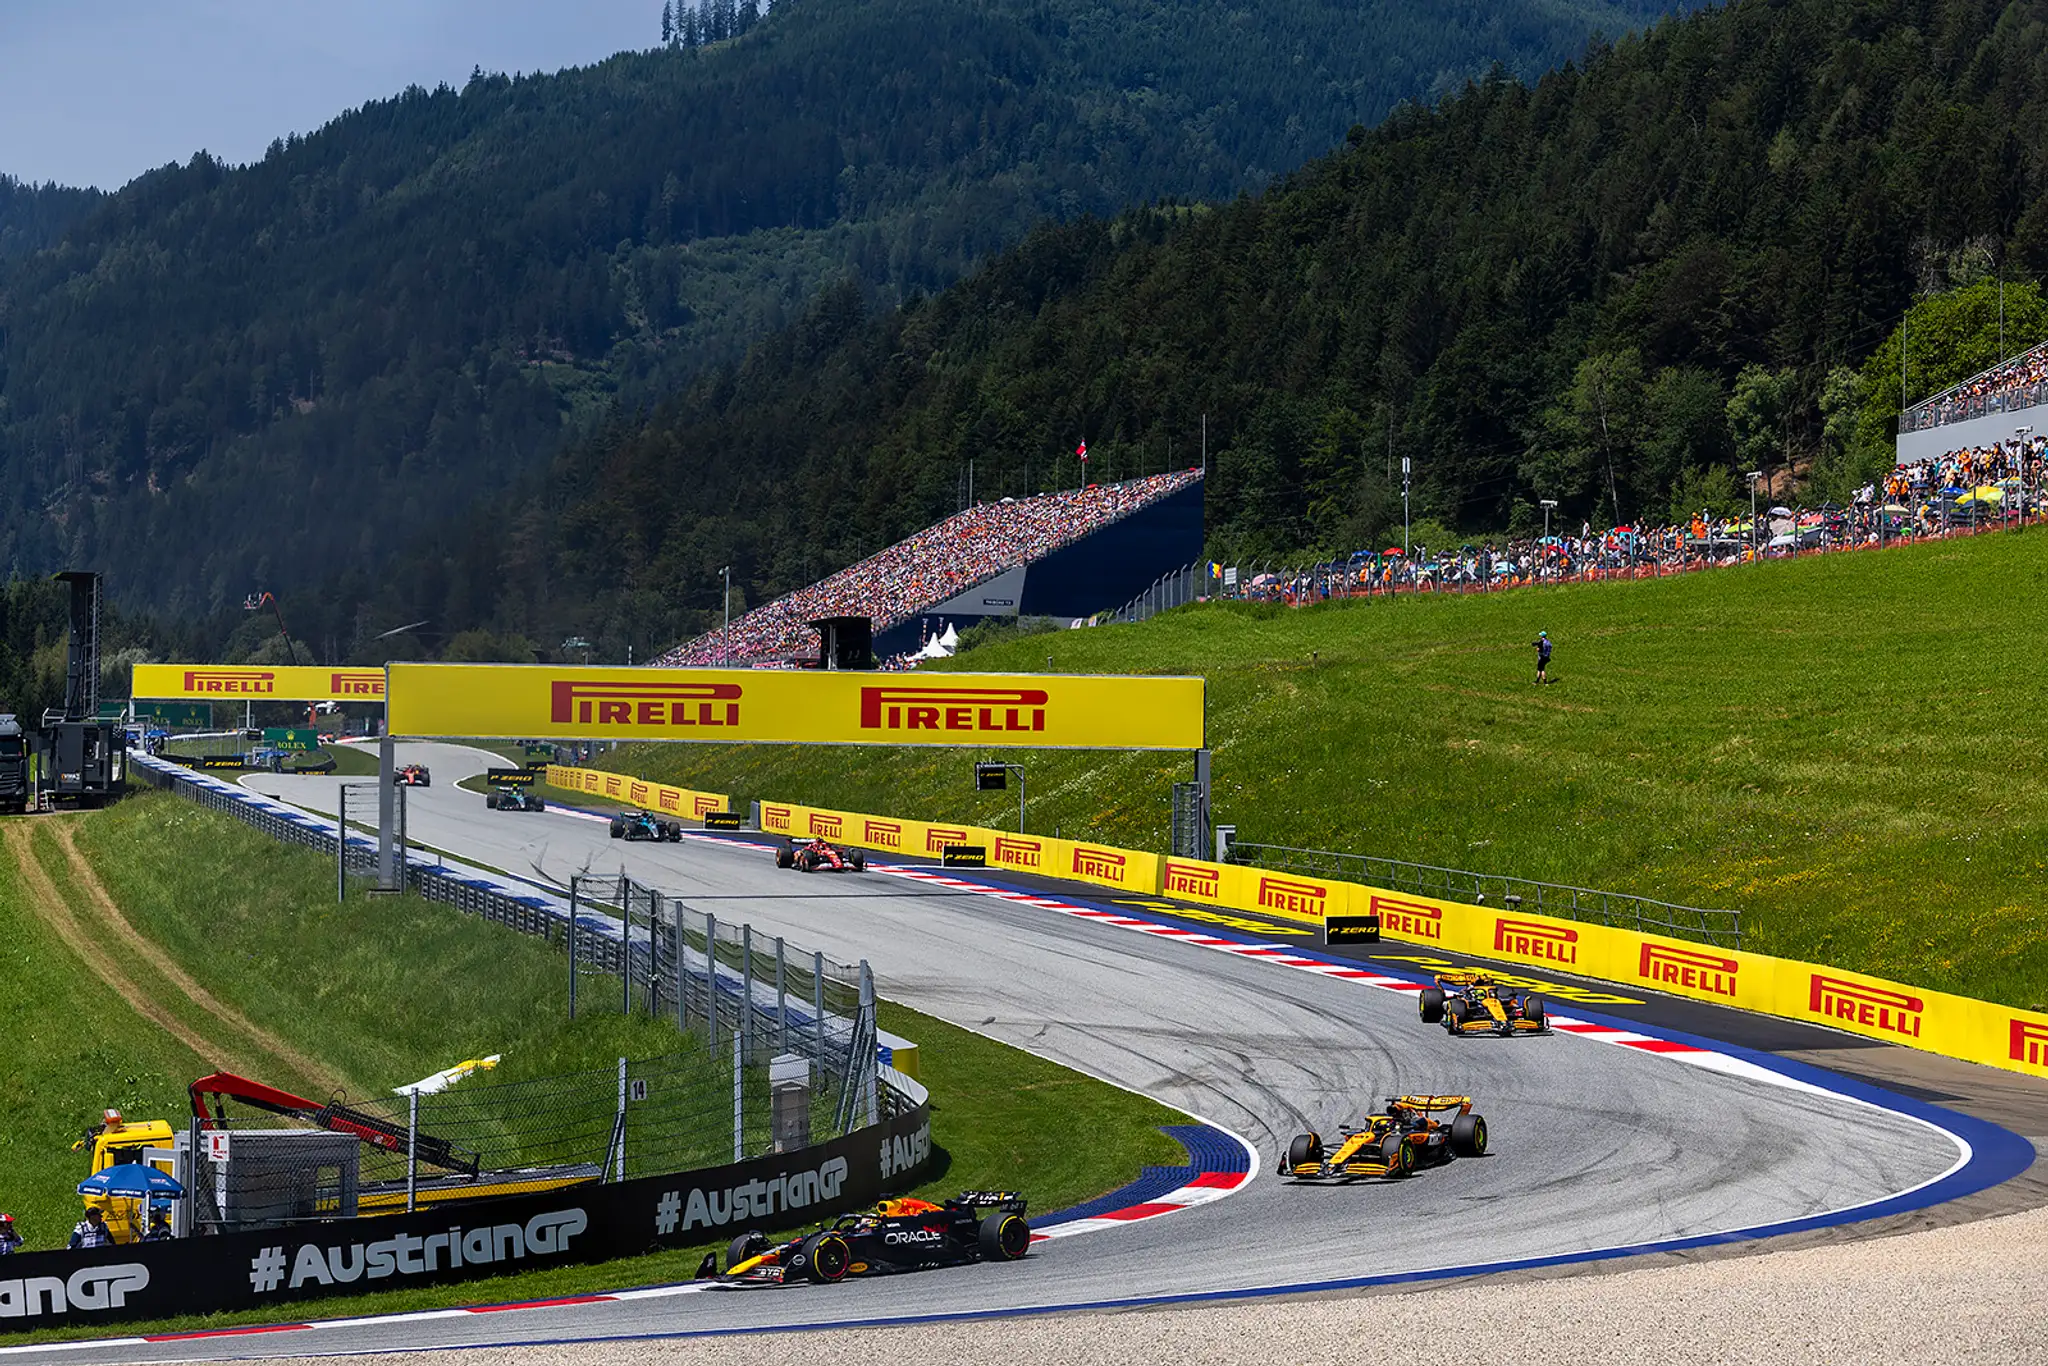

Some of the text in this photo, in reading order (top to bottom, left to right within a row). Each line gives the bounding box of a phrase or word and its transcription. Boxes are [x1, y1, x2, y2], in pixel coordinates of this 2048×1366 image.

[184, 672, 275, 692] PIRELLI
[331, 673, 385, 694] PIRE
[551, 681, 743, 726] PIRELLI
[861, 687, 1049, 731] PIRELLI
[766, 807, 791, 829] PIRELLI
[809, 813, 843, 839] PIRELLI
[865, 820, 902, 848] PIRELLI
[994, 837, 1041, 867] PIRELLI
[1072, 848, 1126, 882] PIRELLI
[1164, 863, 1220, 898] PIRELLI
[1258, 877, 1327, 917] PIRELLI
[1329, 926, 1378, 935] P ZERO
[1370, 895, 1443, 940] PIRELLI
[1494, 918, 1579, 965] PIRELLI
[1639, 943, 1739, 997] PIRELLI
[1809, 974, 1924, 1038] PIRELLI
[633, 1081, 645, 1100] 14
[885, 1231, 942, 1245] ORACLE
